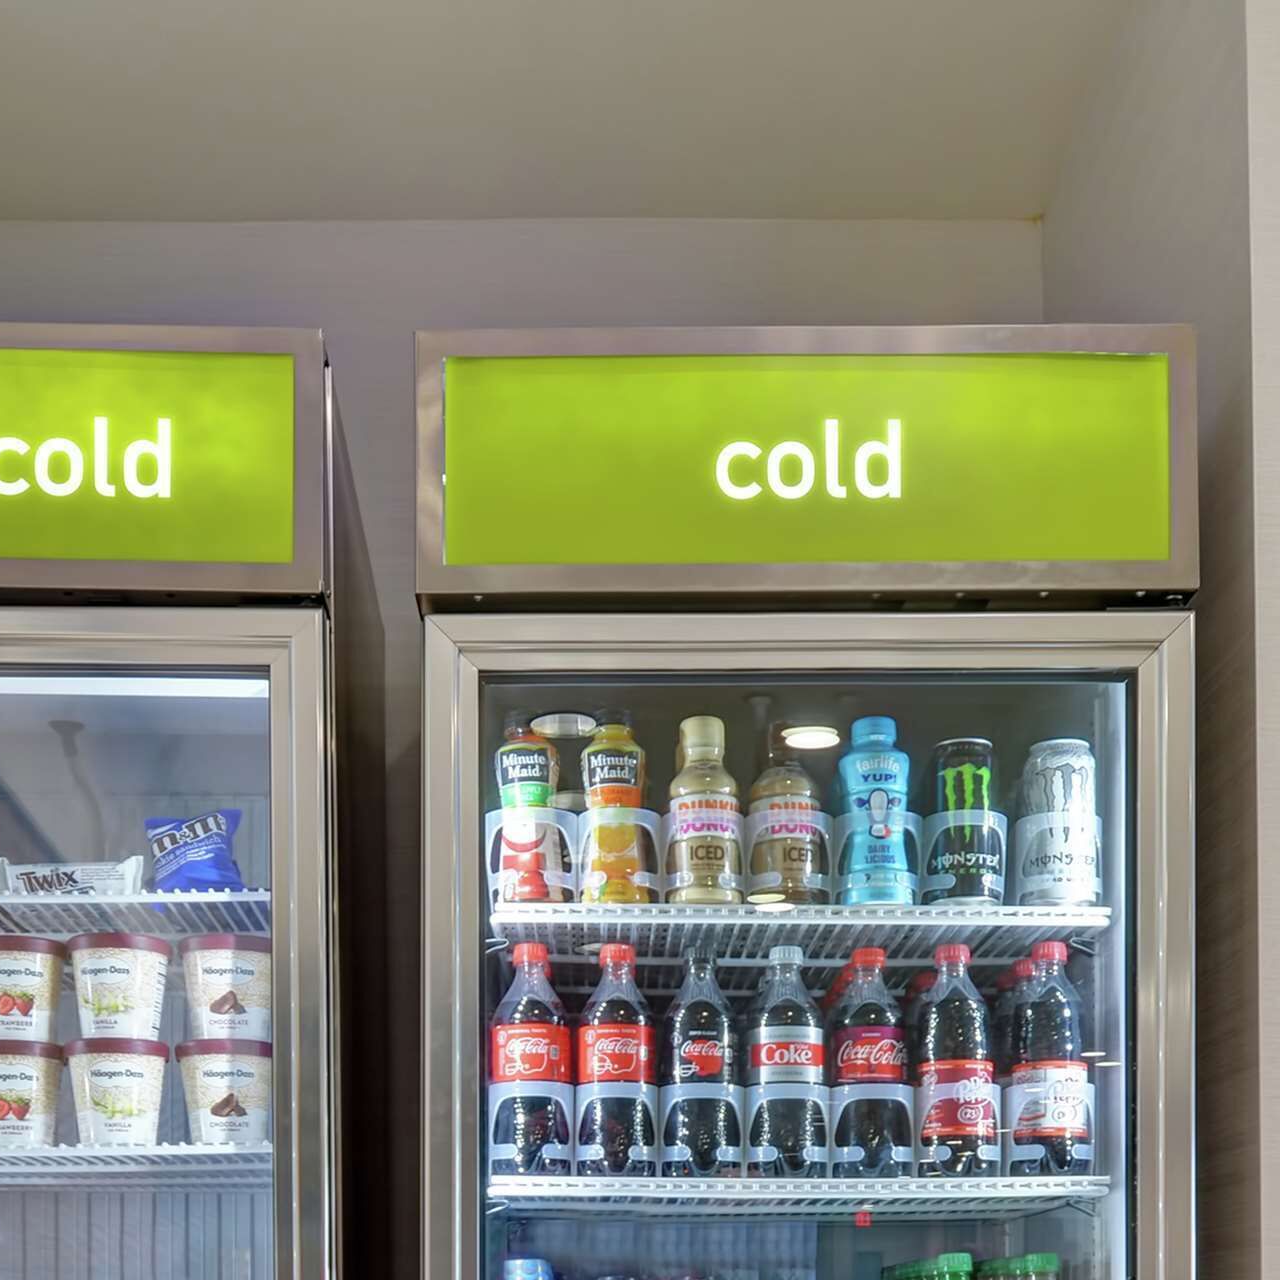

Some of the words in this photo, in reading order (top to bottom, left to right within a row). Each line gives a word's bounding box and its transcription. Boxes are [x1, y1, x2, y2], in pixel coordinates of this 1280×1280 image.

[713, 418, 902, 500] cold
[502, 753, 547, 768] Minute
[589, 754, 637, 768] Minute
[855, 757, 900, 773] fairlife
[507, 764, 543, 779] Maid
[596, 765, 630, 779] Maid
[861, 773, 897, 783] YUP!
[690, 844, 725, 861] ICED
[680, 1039, 726, 1057] Coca-Cola
[759, 1044, 813, 1065] Coke
[836, 1038, 907, 1068] Coca-Cola
